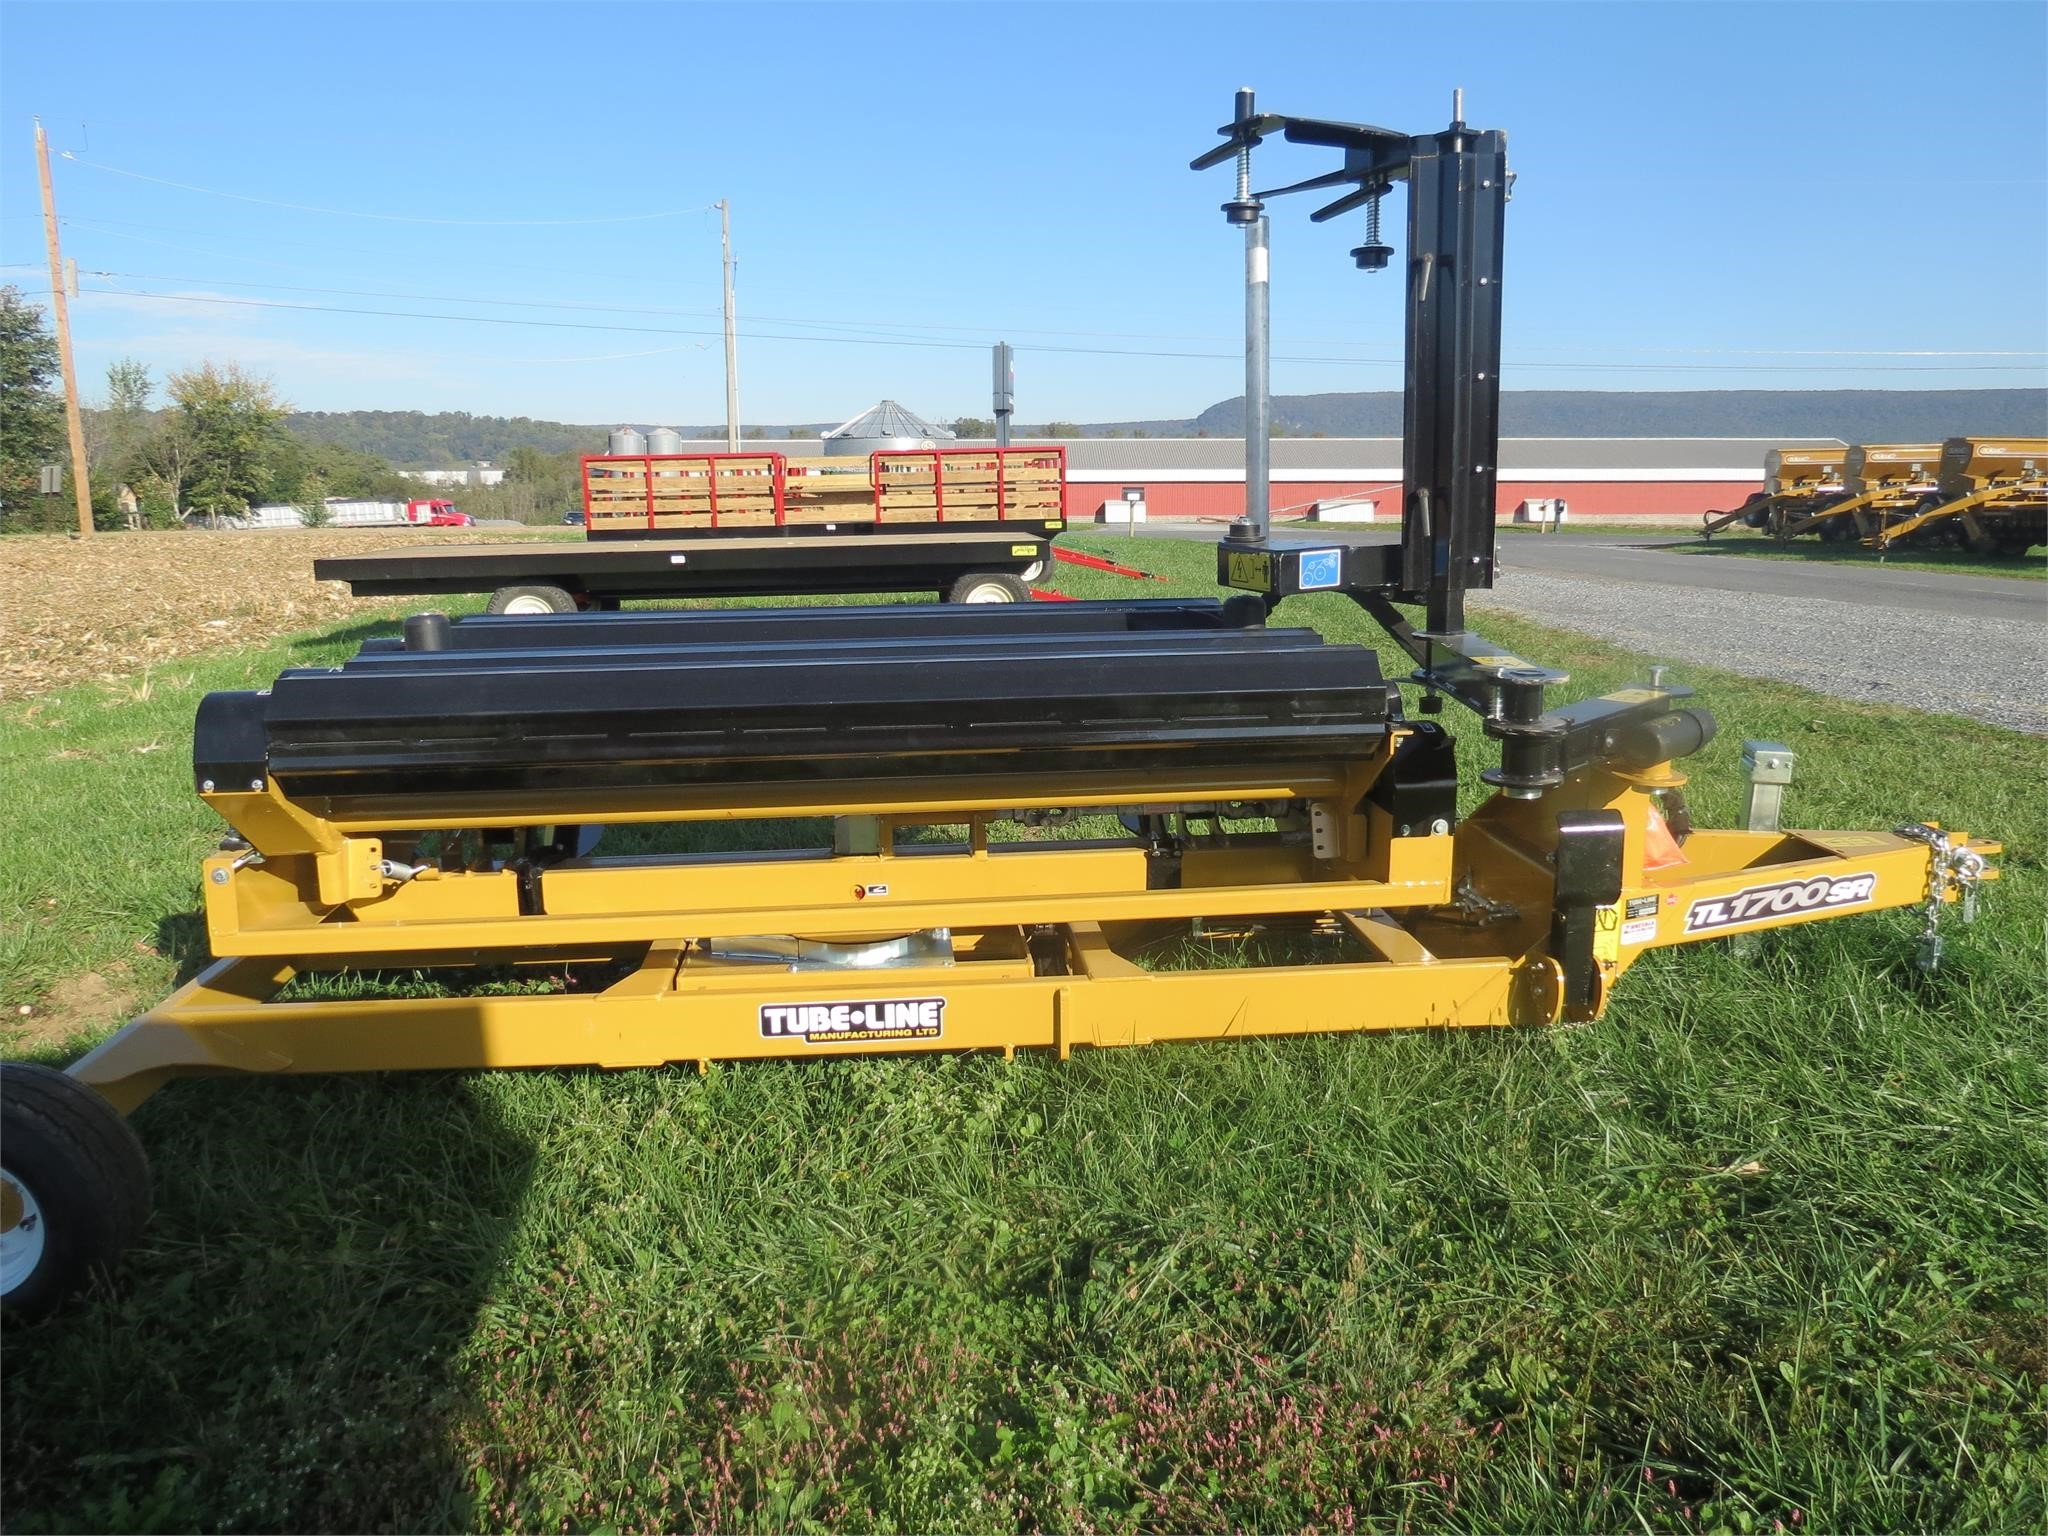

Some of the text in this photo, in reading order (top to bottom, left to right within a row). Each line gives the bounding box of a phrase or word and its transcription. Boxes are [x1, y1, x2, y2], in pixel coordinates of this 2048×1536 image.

[1693, 878, 1873, 925] TL1700SR
[809, 1027, 938, 1041] MANUFACTURING LTD
